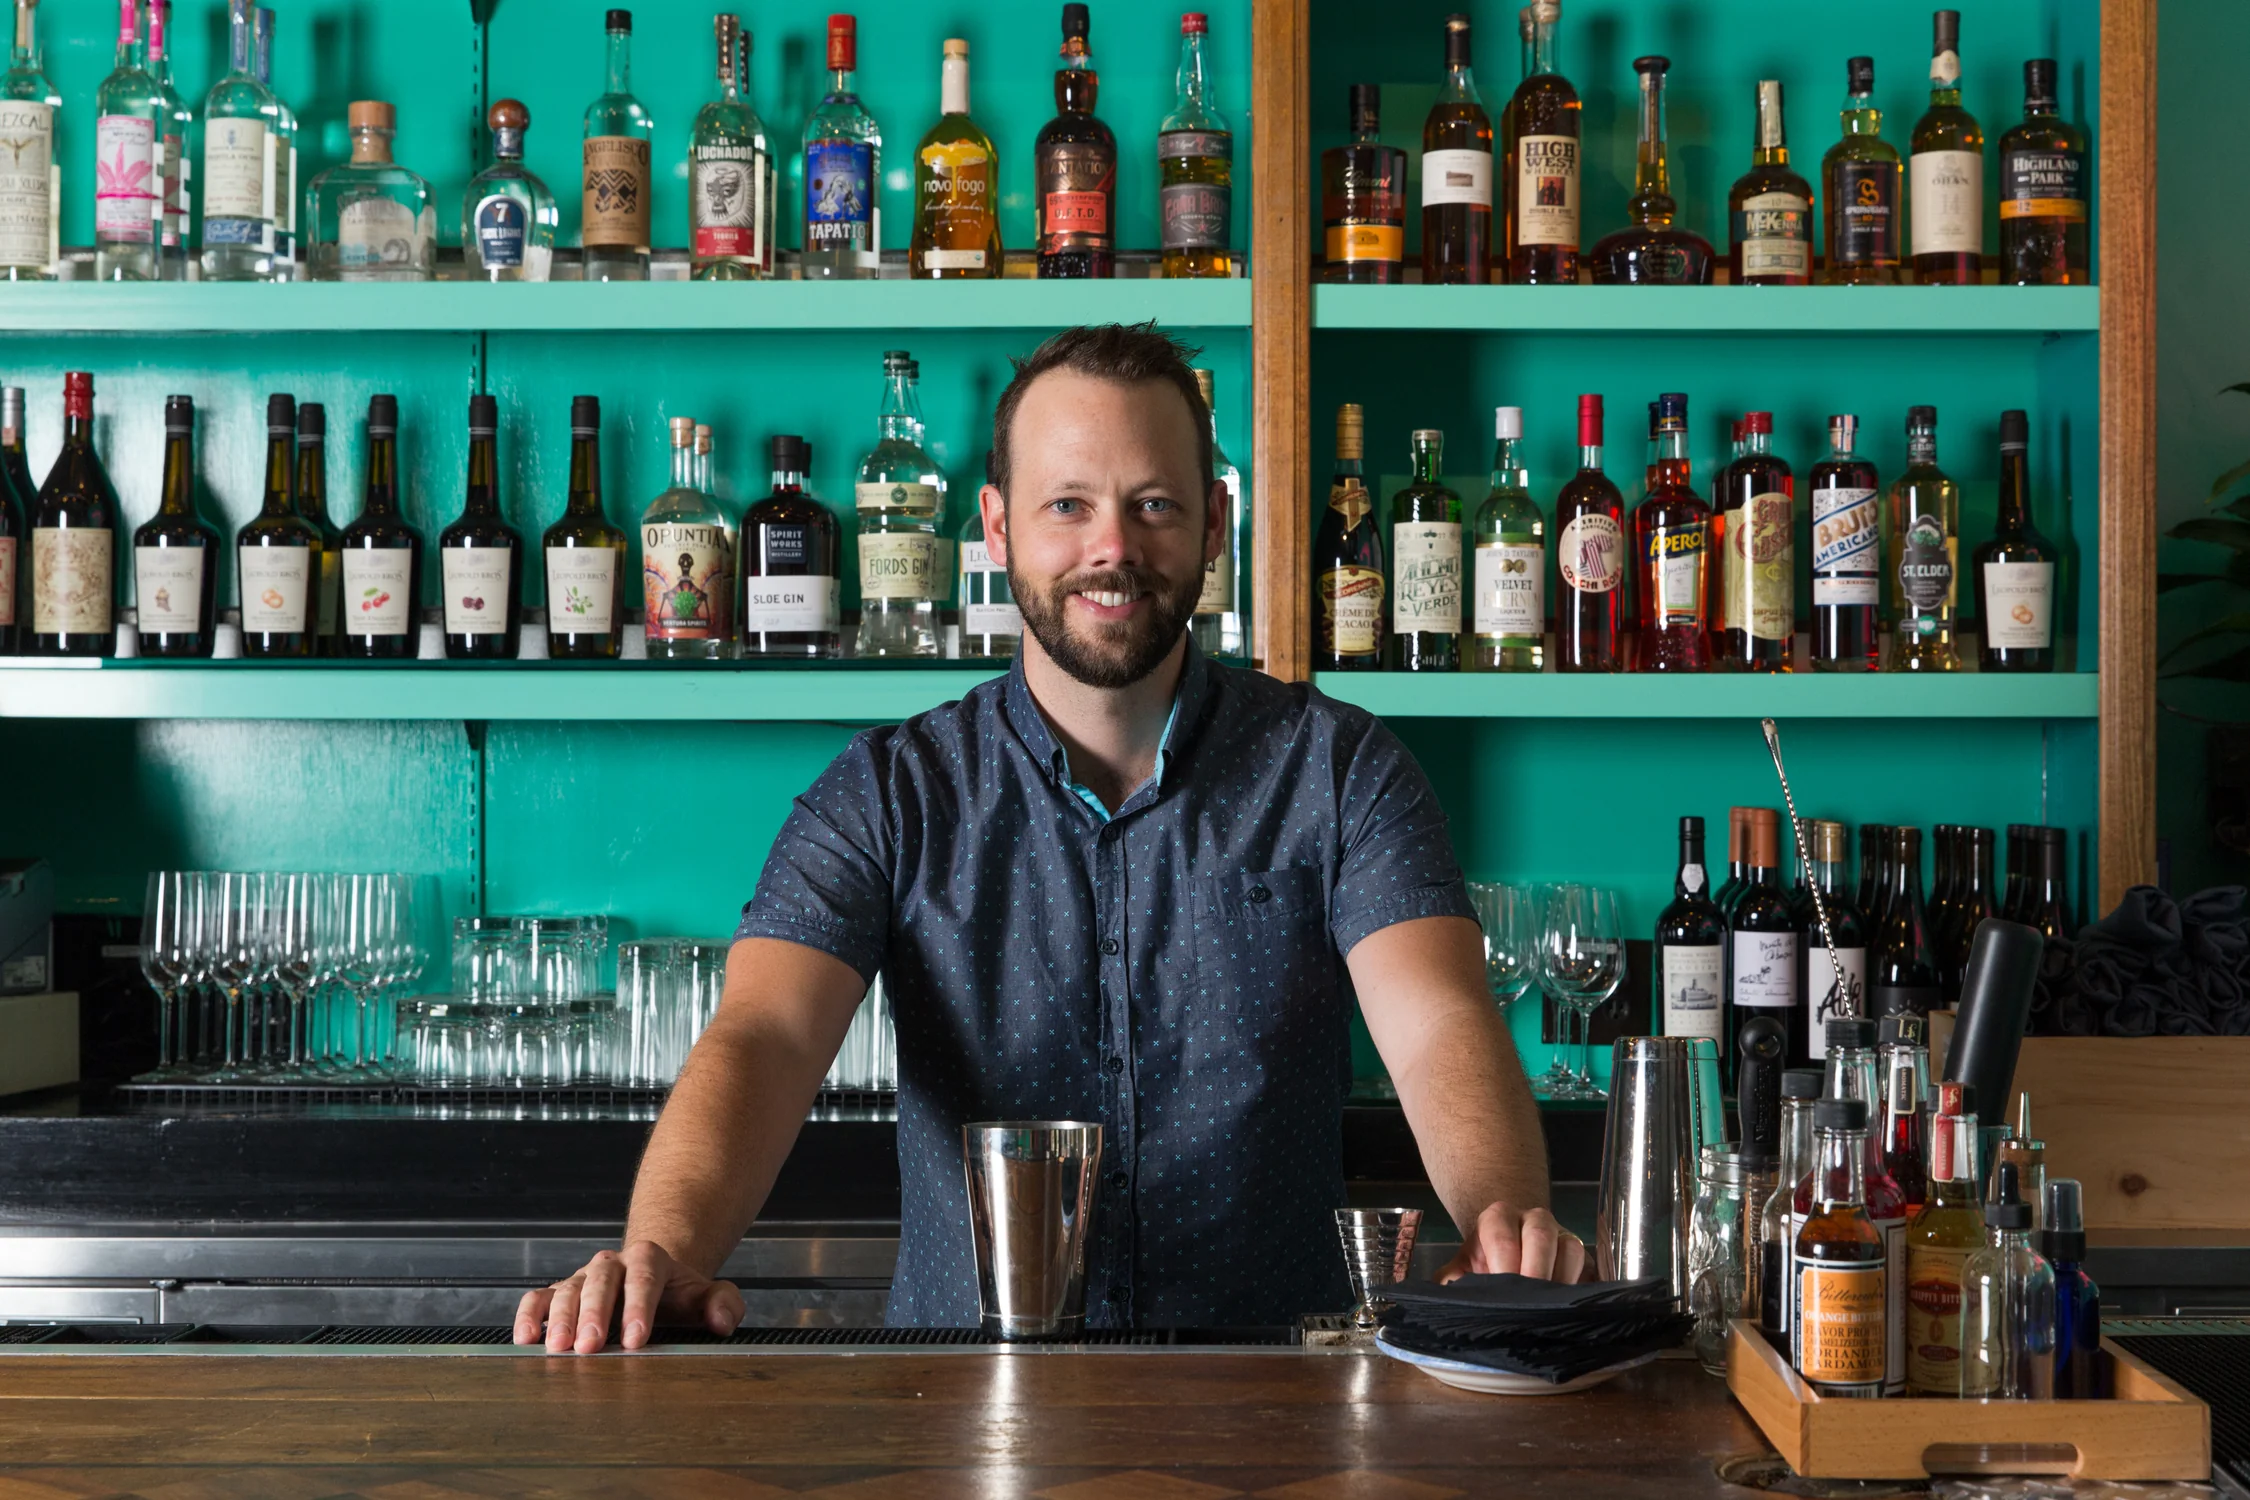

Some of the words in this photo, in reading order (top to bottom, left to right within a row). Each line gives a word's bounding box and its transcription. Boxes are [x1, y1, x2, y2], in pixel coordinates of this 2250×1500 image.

[0, 113, 49, 131] EZCAL
[718, 137, 729, 146] EL
[697, 145, 753, 160] LUCHADOR
[1526, 141, 1575, 158] HIGH
[1526, 157, 1575, 169] WEST
[2013, 157, 2079, 172] HIGHLAND
[924, 180, 952, 193] novo
[957, 176, 985, 196] fogo
[2031, 172, 2064, 185] PARK
[495, 203, 509, 223] 7
[809, 223, 867, 240] TAPATIO
[1817, 502, 1878, 547] BRUTO
[648, 527, 720, 549] OPUNTIA
[770, 530, 802, 539] SPIRIT
[770, 540, 802, 548] WORKS
[869, 558, 907, 575] FORDS
[912, 558, 929, 575] GIN
[1918, 564, 1949, 577] ELDER
[1401, 577, 1459, 601] REYES
[1494, 579, 1533, 591] VELVET
[754, 594, 780, 605] SLOE
[784, 594, 805, 604] GIN
[1413, 595, 1457, 617] VERDE
[1805, 1346, 1882, 1358] CORIANDER
